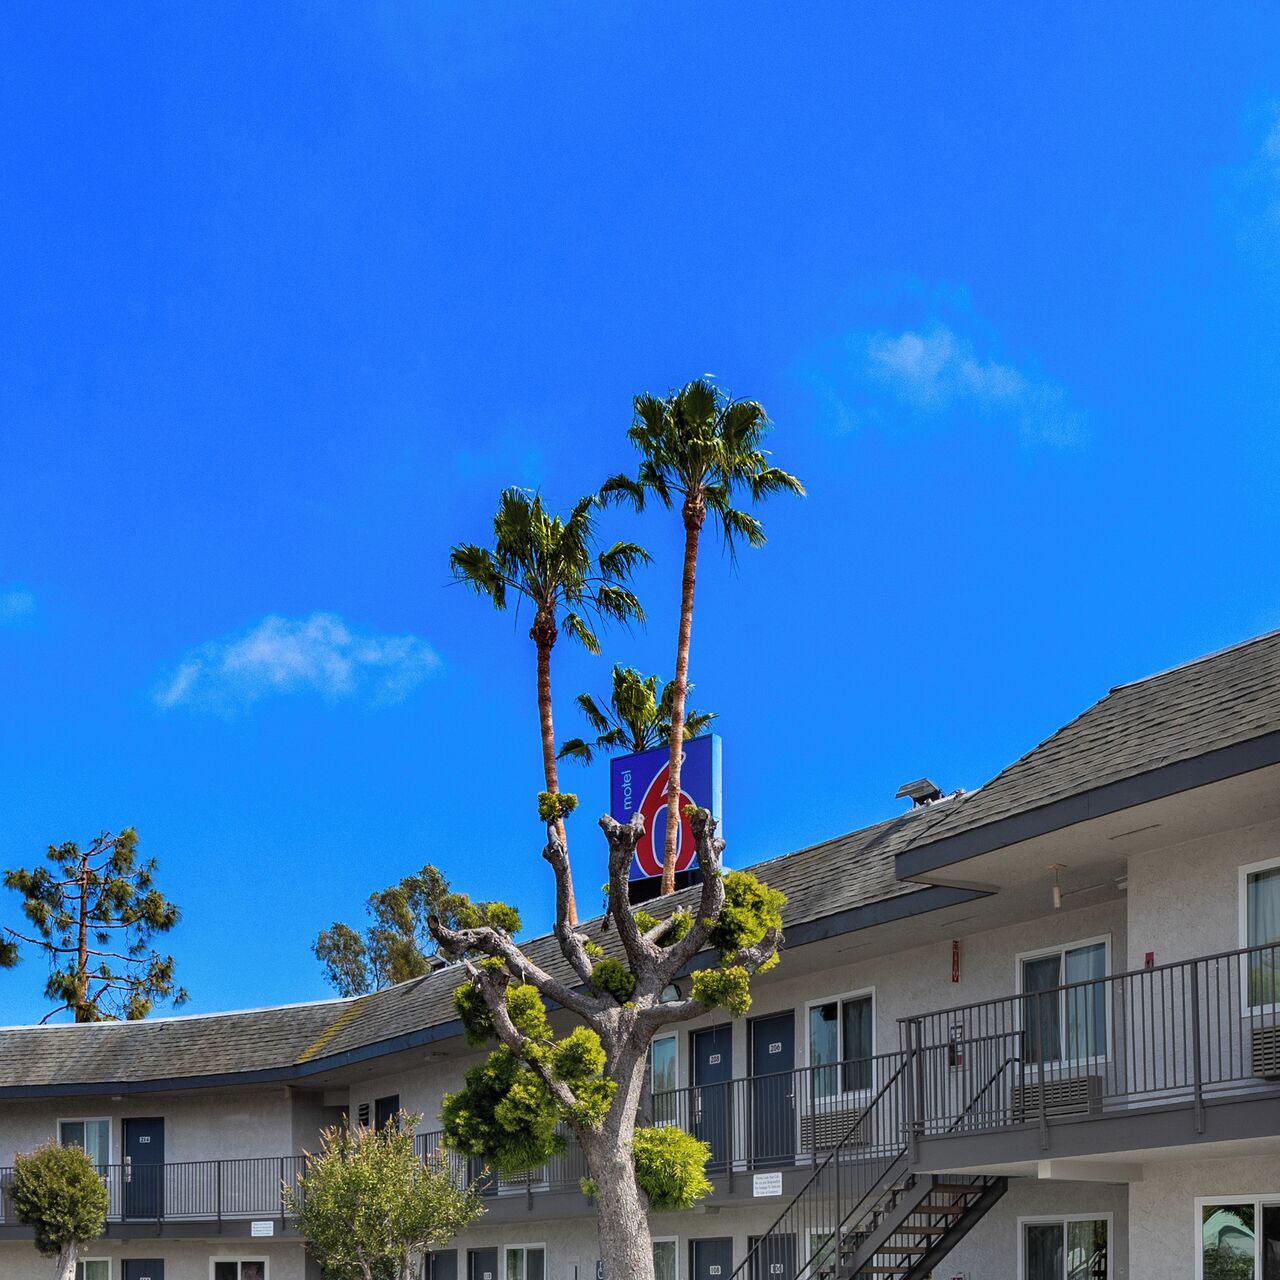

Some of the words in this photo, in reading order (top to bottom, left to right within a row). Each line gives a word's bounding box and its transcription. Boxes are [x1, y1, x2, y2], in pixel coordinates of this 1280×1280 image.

[621, 769, 632, 810] motel
[634, 751, 698, 877] 6
[710, 1055, 720, 1063] 208
[770, 1043, 781, 1053] 206
